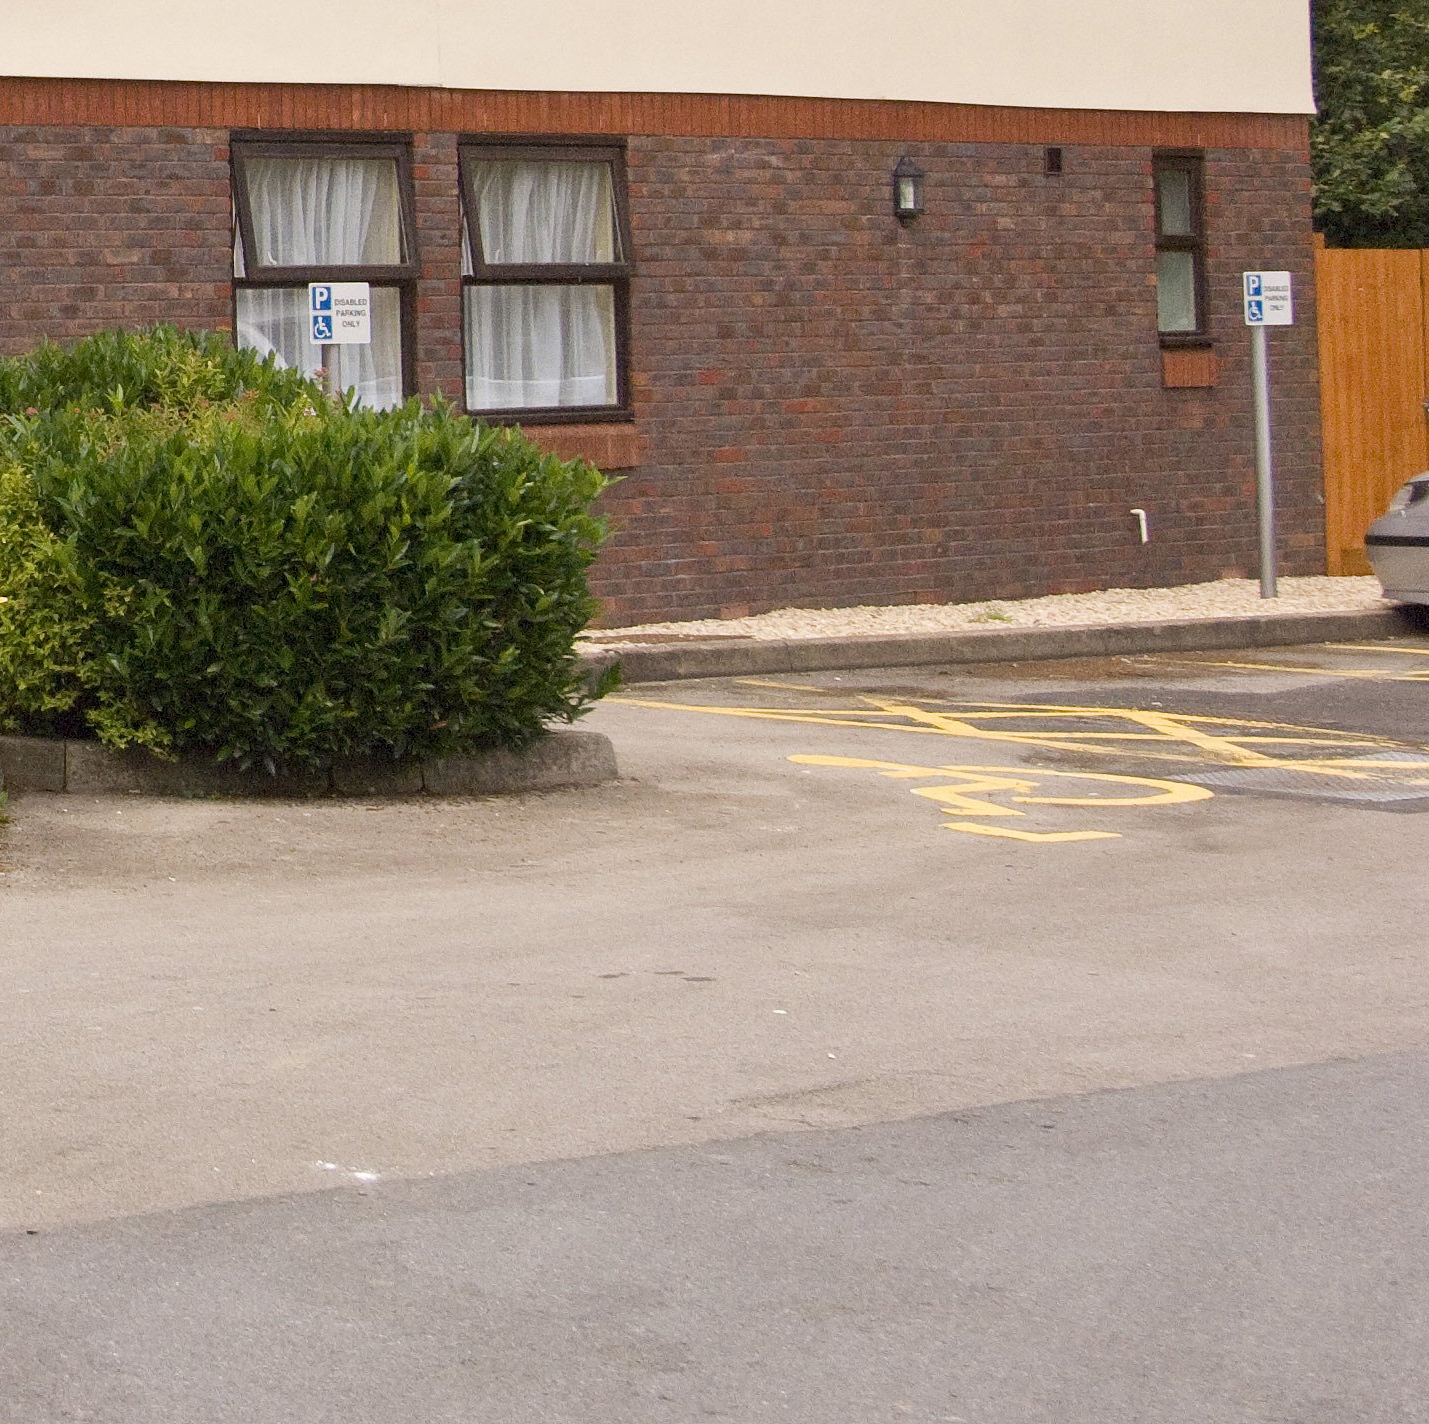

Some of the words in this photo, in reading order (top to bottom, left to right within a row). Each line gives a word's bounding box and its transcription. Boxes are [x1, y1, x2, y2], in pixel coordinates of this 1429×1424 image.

[1250, 276, 1259, 295] P
[315, 287, 327, 309] P
[334, 298, 367, 306] DISABLED
[335, 309, 367, 317] PARKING
[342, 320, 360, 328] ONLY
